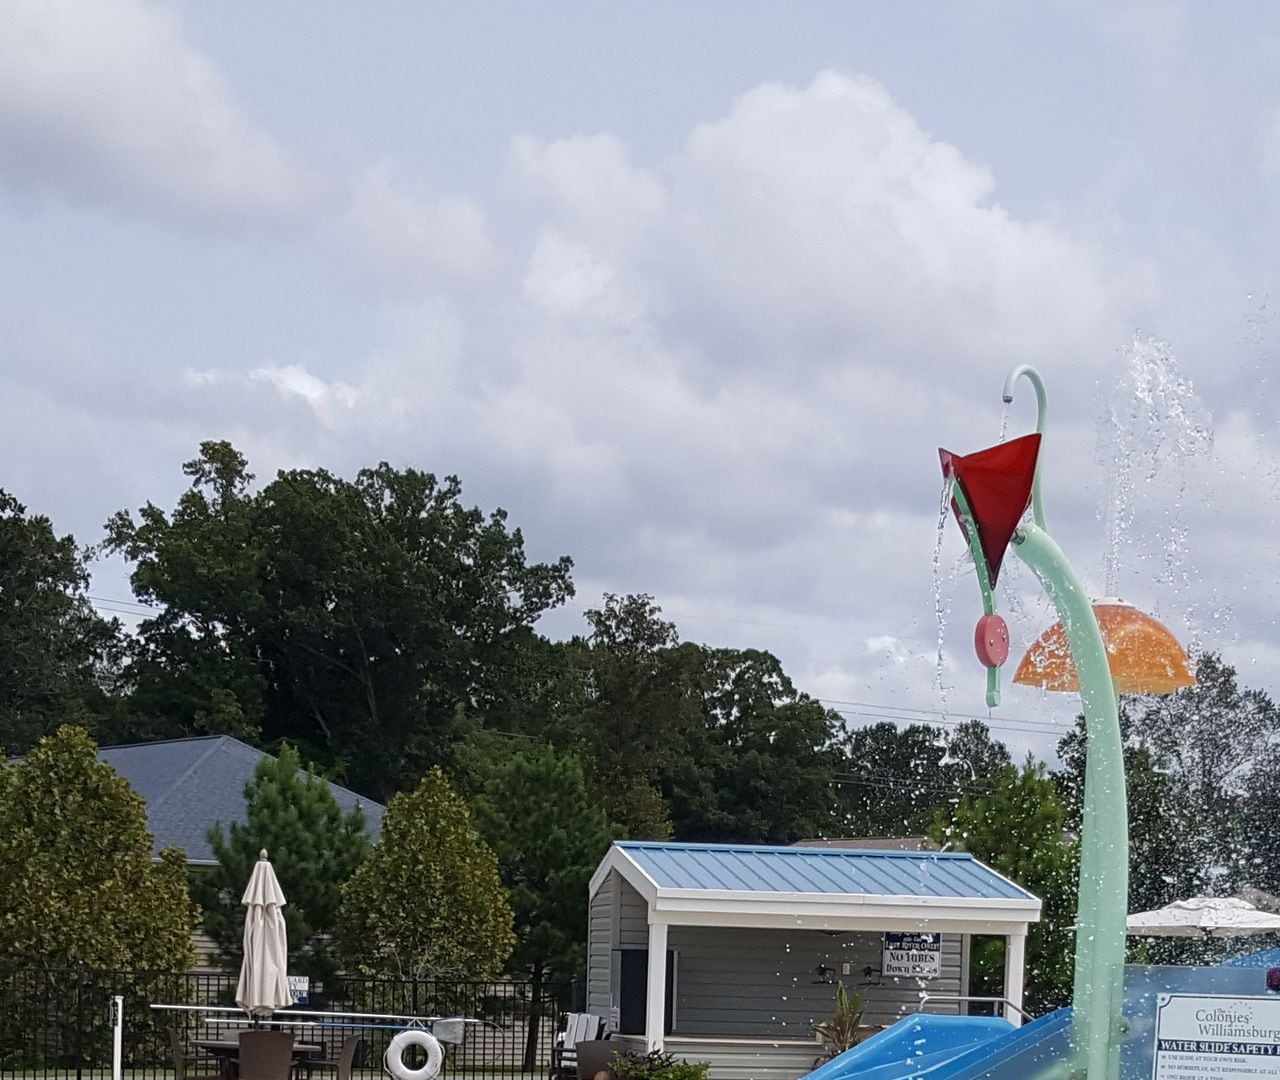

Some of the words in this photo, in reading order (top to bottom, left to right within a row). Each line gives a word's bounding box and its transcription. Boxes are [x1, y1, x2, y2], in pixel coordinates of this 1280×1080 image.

[889, 952, 904, 962] NO
[1195, 1008, 1249, 1024] Colonies
[1197, 1023, 1280, 1041] Williamsburg
[1161, 1040, 1197, 1050] WATER
[1199, 1042, 1229, 1052] SLIDE
[1231, 1043, 1273, 1054] SAFETY
